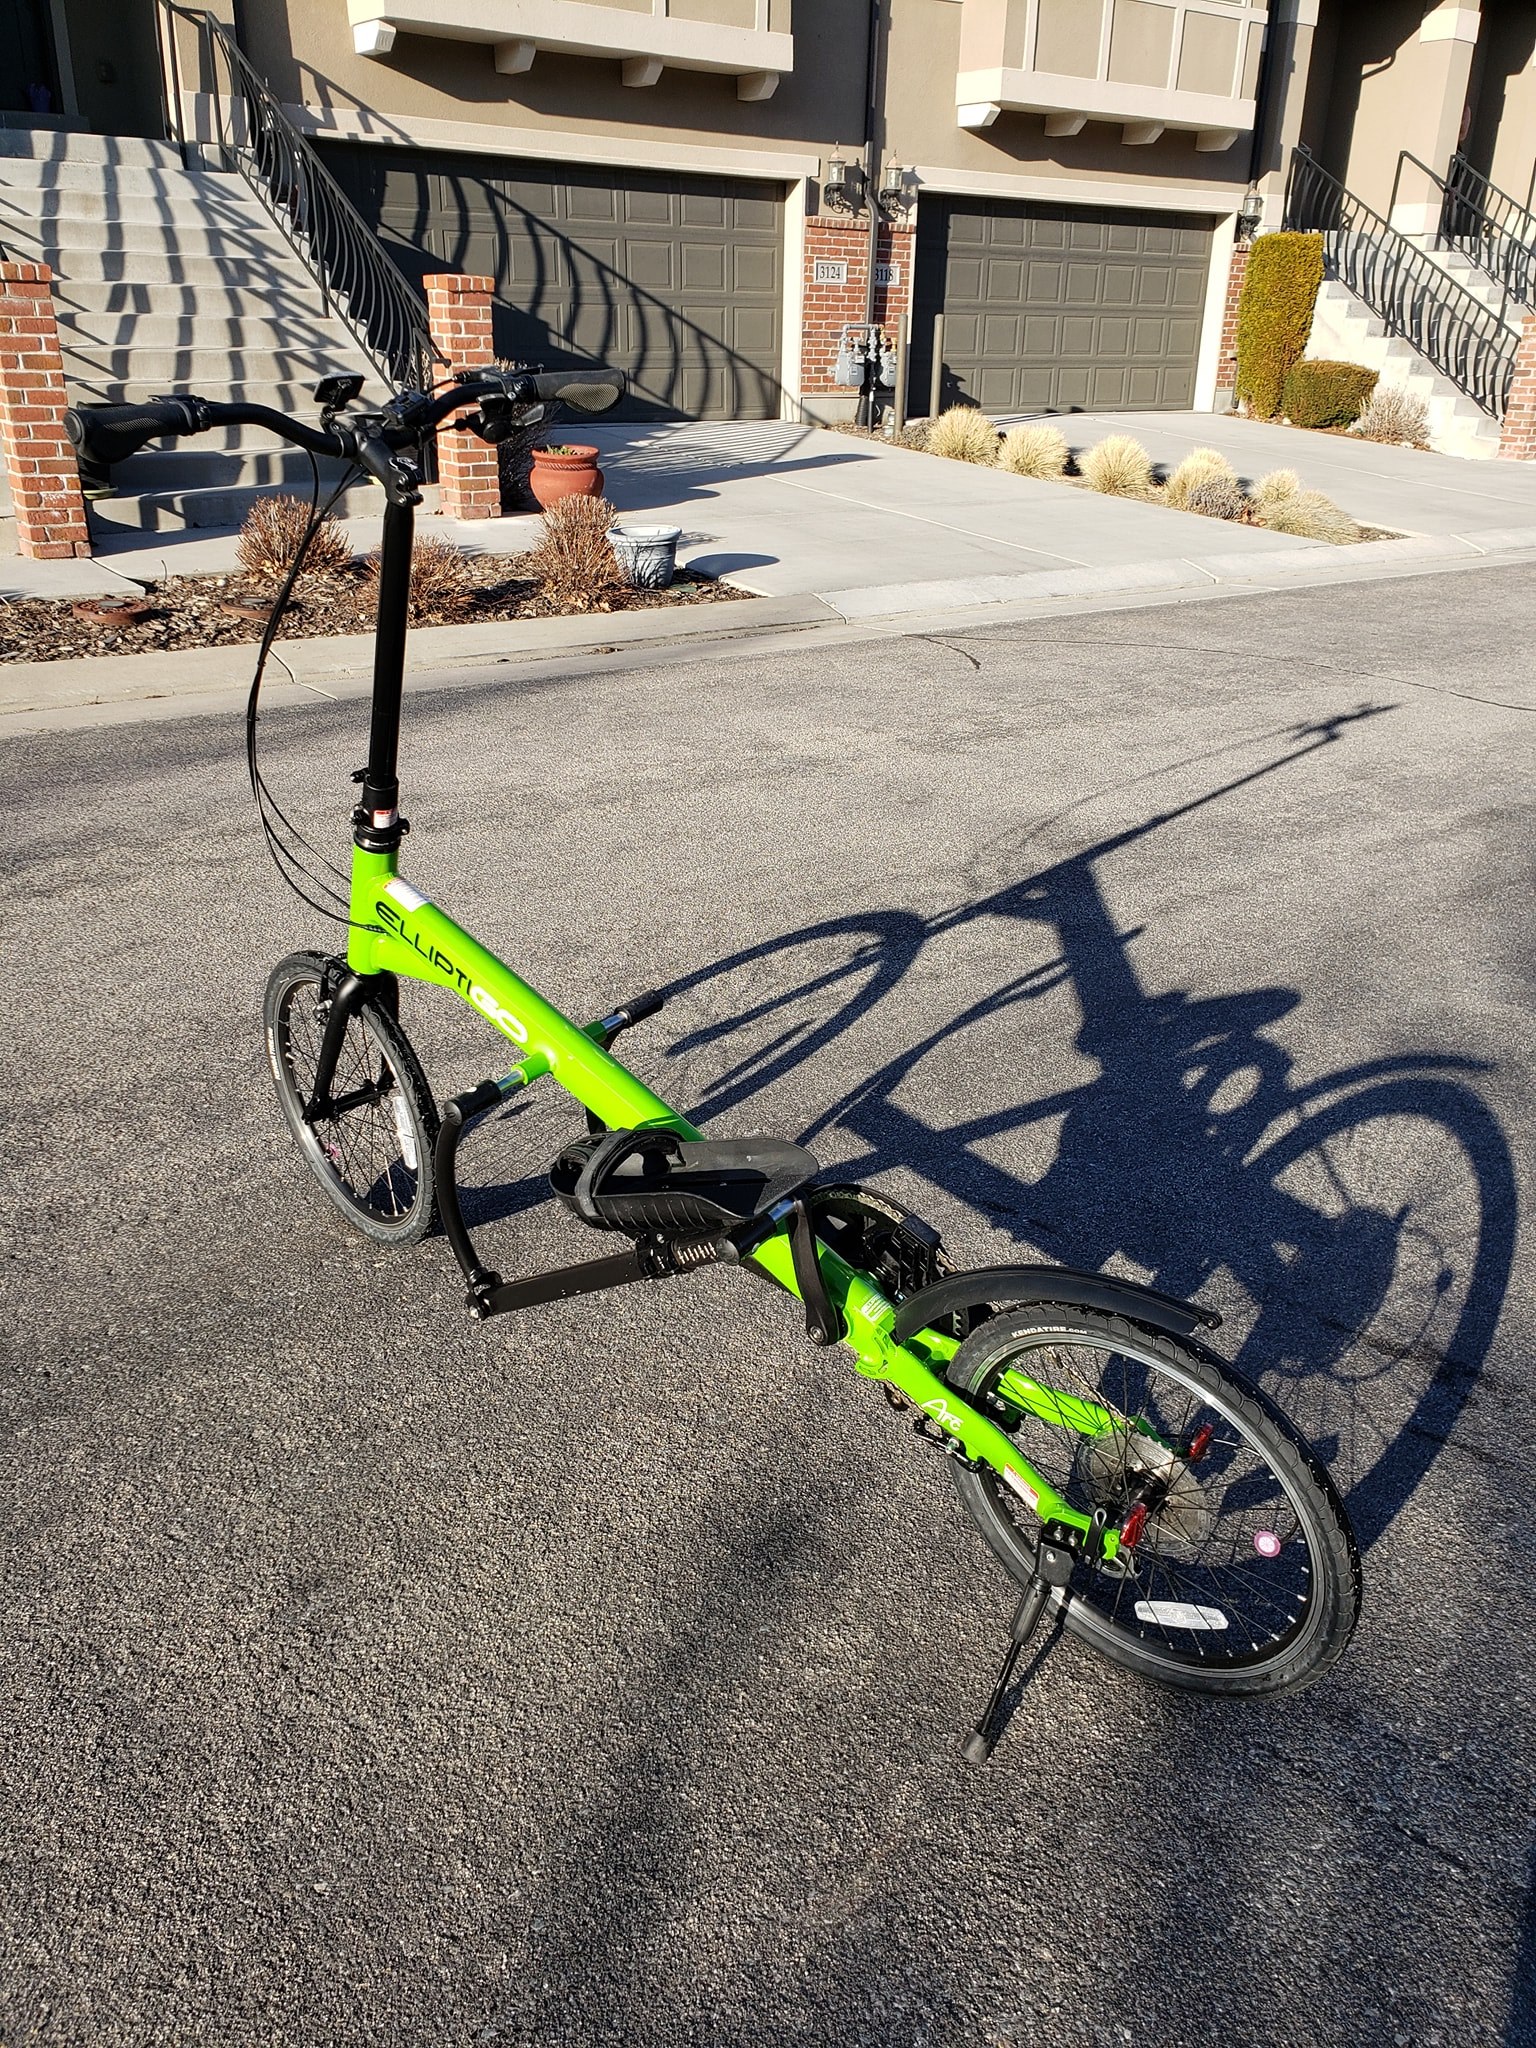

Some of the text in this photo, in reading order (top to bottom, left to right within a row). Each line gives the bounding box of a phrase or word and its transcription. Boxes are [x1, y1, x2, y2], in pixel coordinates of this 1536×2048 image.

[820, 266, 840, 279] 3124
[875, 268, 894, 281] 3118
[921, 1398, 964, 1432] Arc
